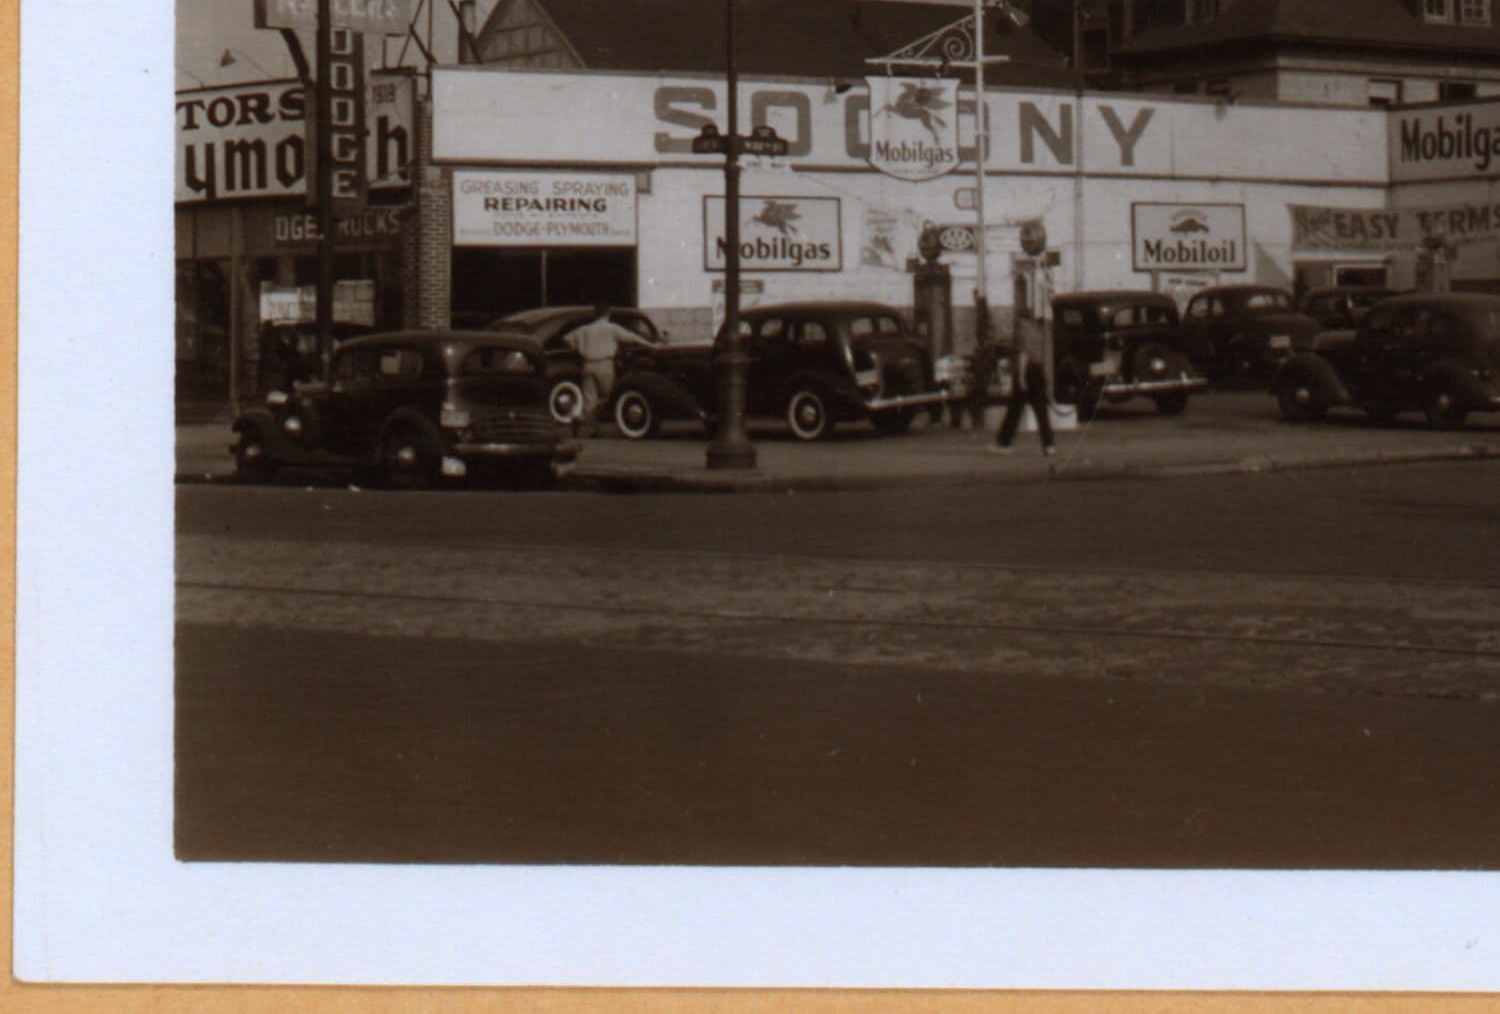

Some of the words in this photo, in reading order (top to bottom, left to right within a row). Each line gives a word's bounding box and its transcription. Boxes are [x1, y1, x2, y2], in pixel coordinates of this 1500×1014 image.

[184, 116, 411, 201] ymoh
[875, 139, 955, 169] Mobilgas
[459, 177, 540, 195] GREASING
[551, 179, 631, 197] SPRAYING
[483, 197, 608, 213] REPAIRING
[1333, 212, 1400, 239] EASY
[1142, 238, 1236, 263] Mobiloil
